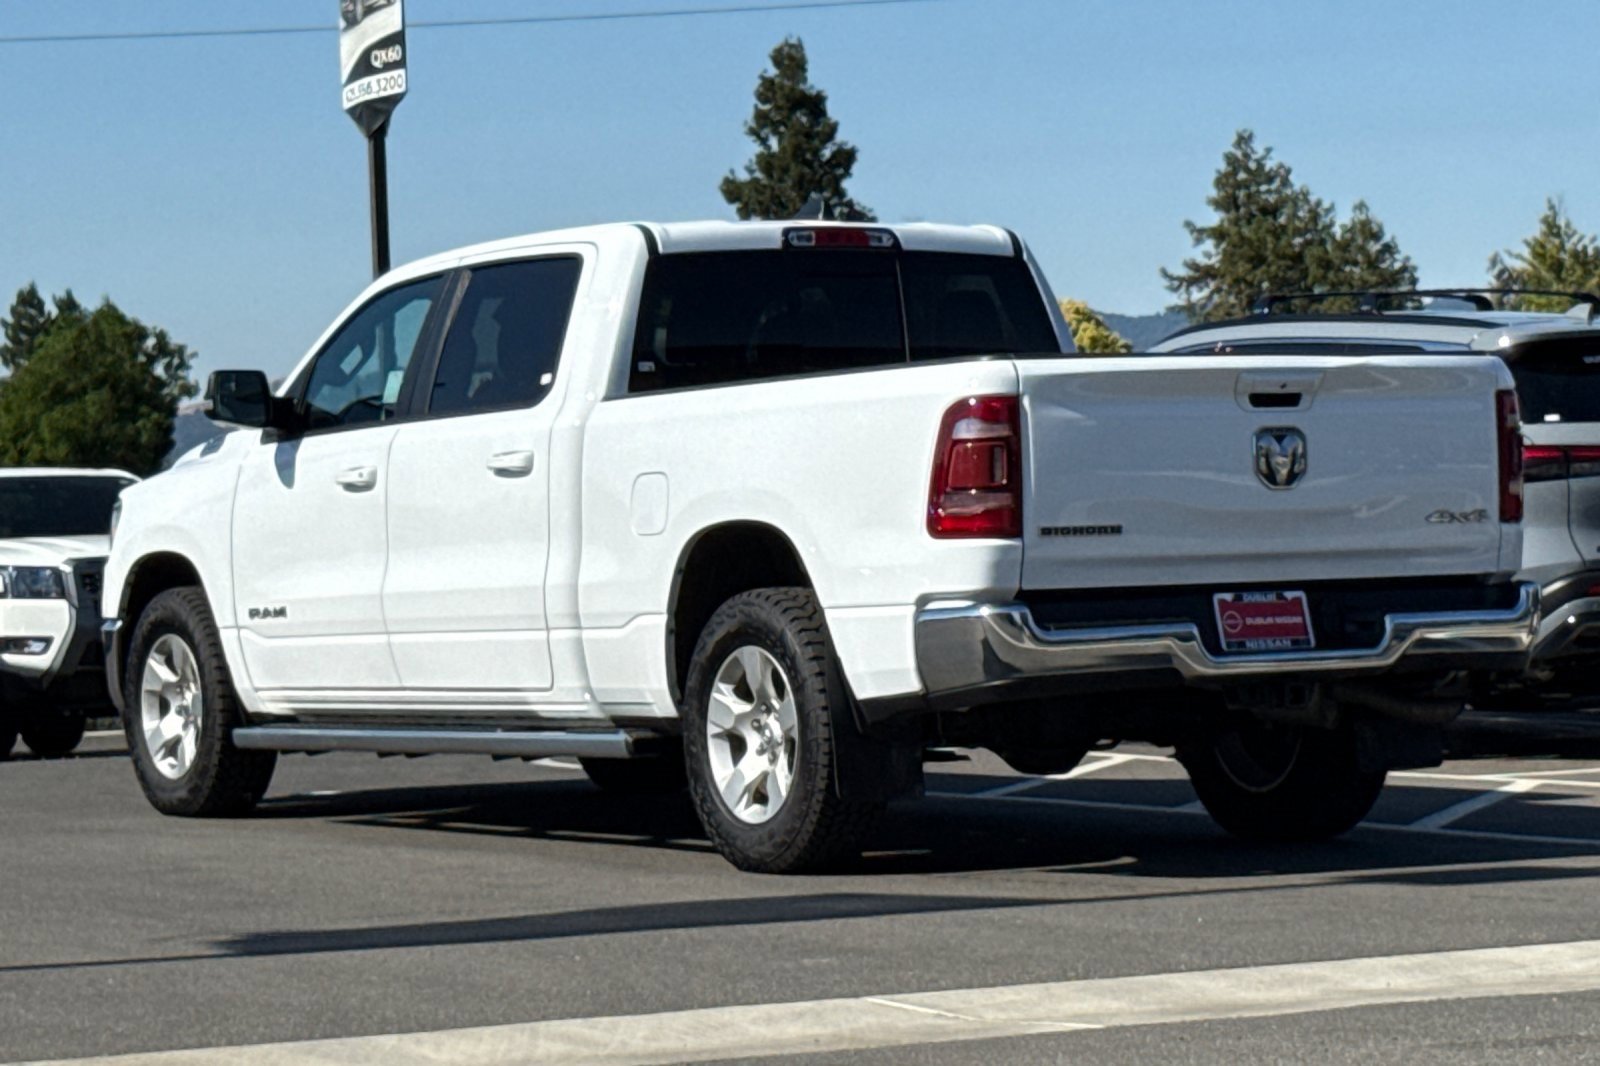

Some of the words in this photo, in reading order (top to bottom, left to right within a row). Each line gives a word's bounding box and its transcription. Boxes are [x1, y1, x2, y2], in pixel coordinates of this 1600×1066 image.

[370, 44, 402, 68] QX60
[248, 606, 287, 620] RAM
[1245, 639, 1291, 648] NISSAN
